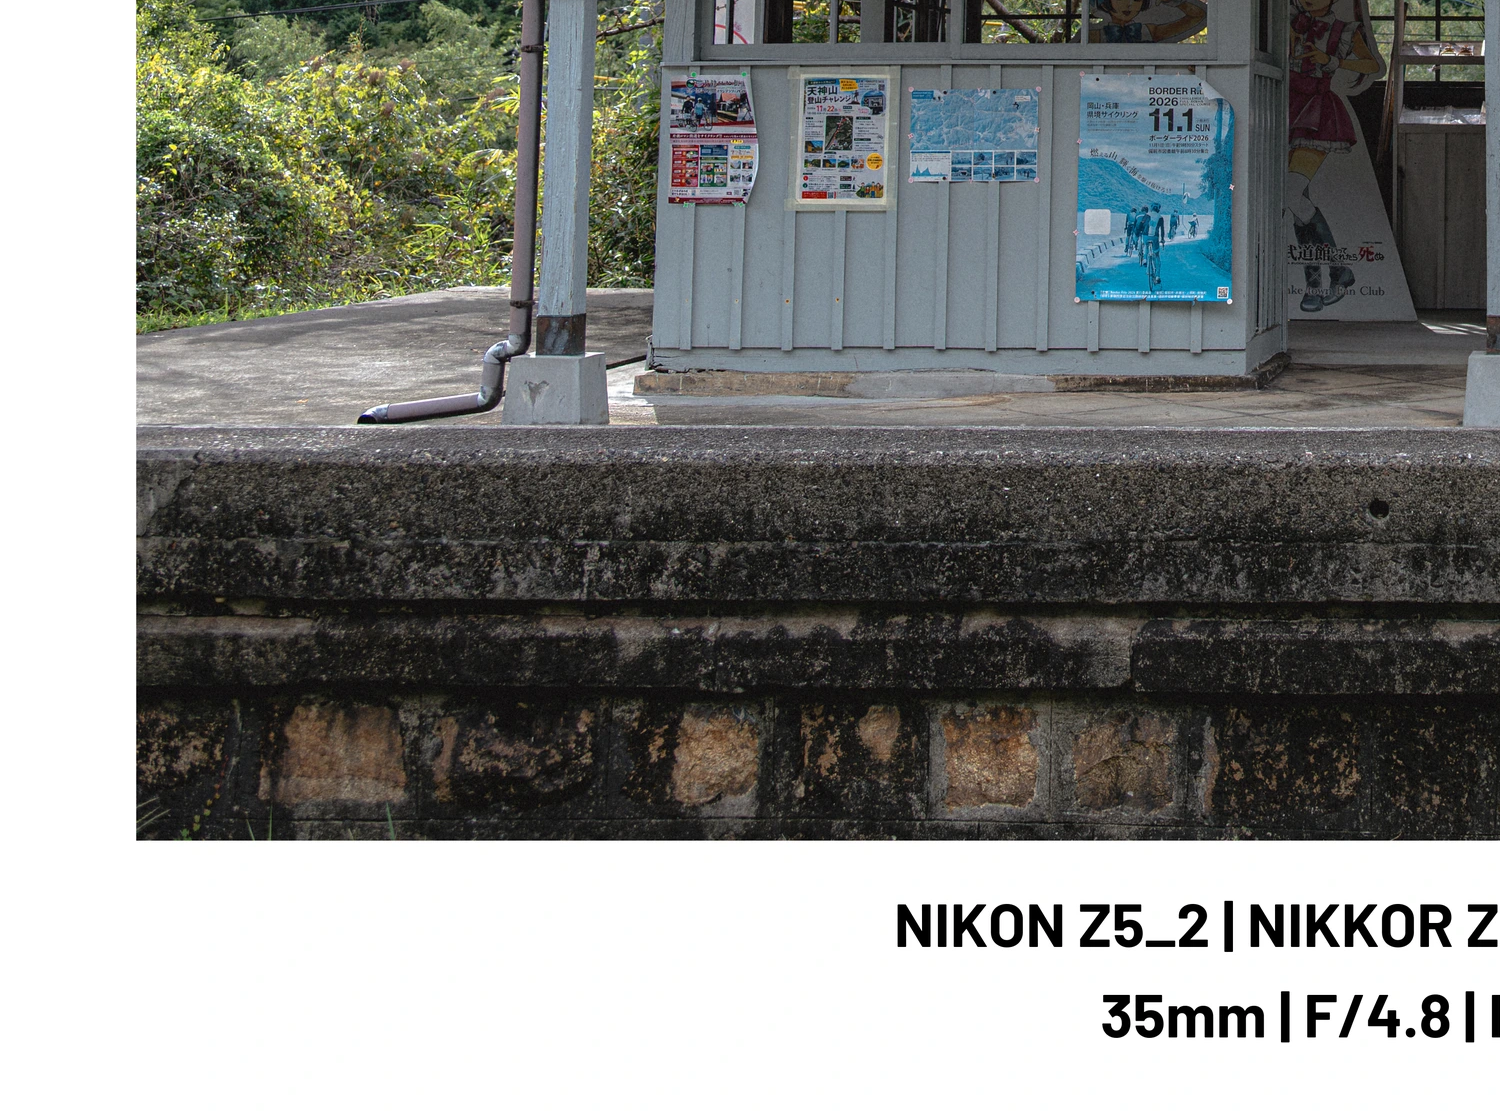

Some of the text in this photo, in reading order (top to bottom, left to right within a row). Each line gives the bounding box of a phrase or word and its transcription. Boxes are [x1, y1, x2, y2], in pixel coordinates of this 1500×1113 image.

[807, 86, 838, 96] 天神山
[1149, 87, 1188, 95] BORDER
[807, 95, 851, 104] 登山チャレンジ
[1149, 97, 1179, 106] 2026
[1149, 108, 1193, 132] 11.1
[1195, 123, 1211, 132] SUN
[1360, 286, 1385, 296] Club
